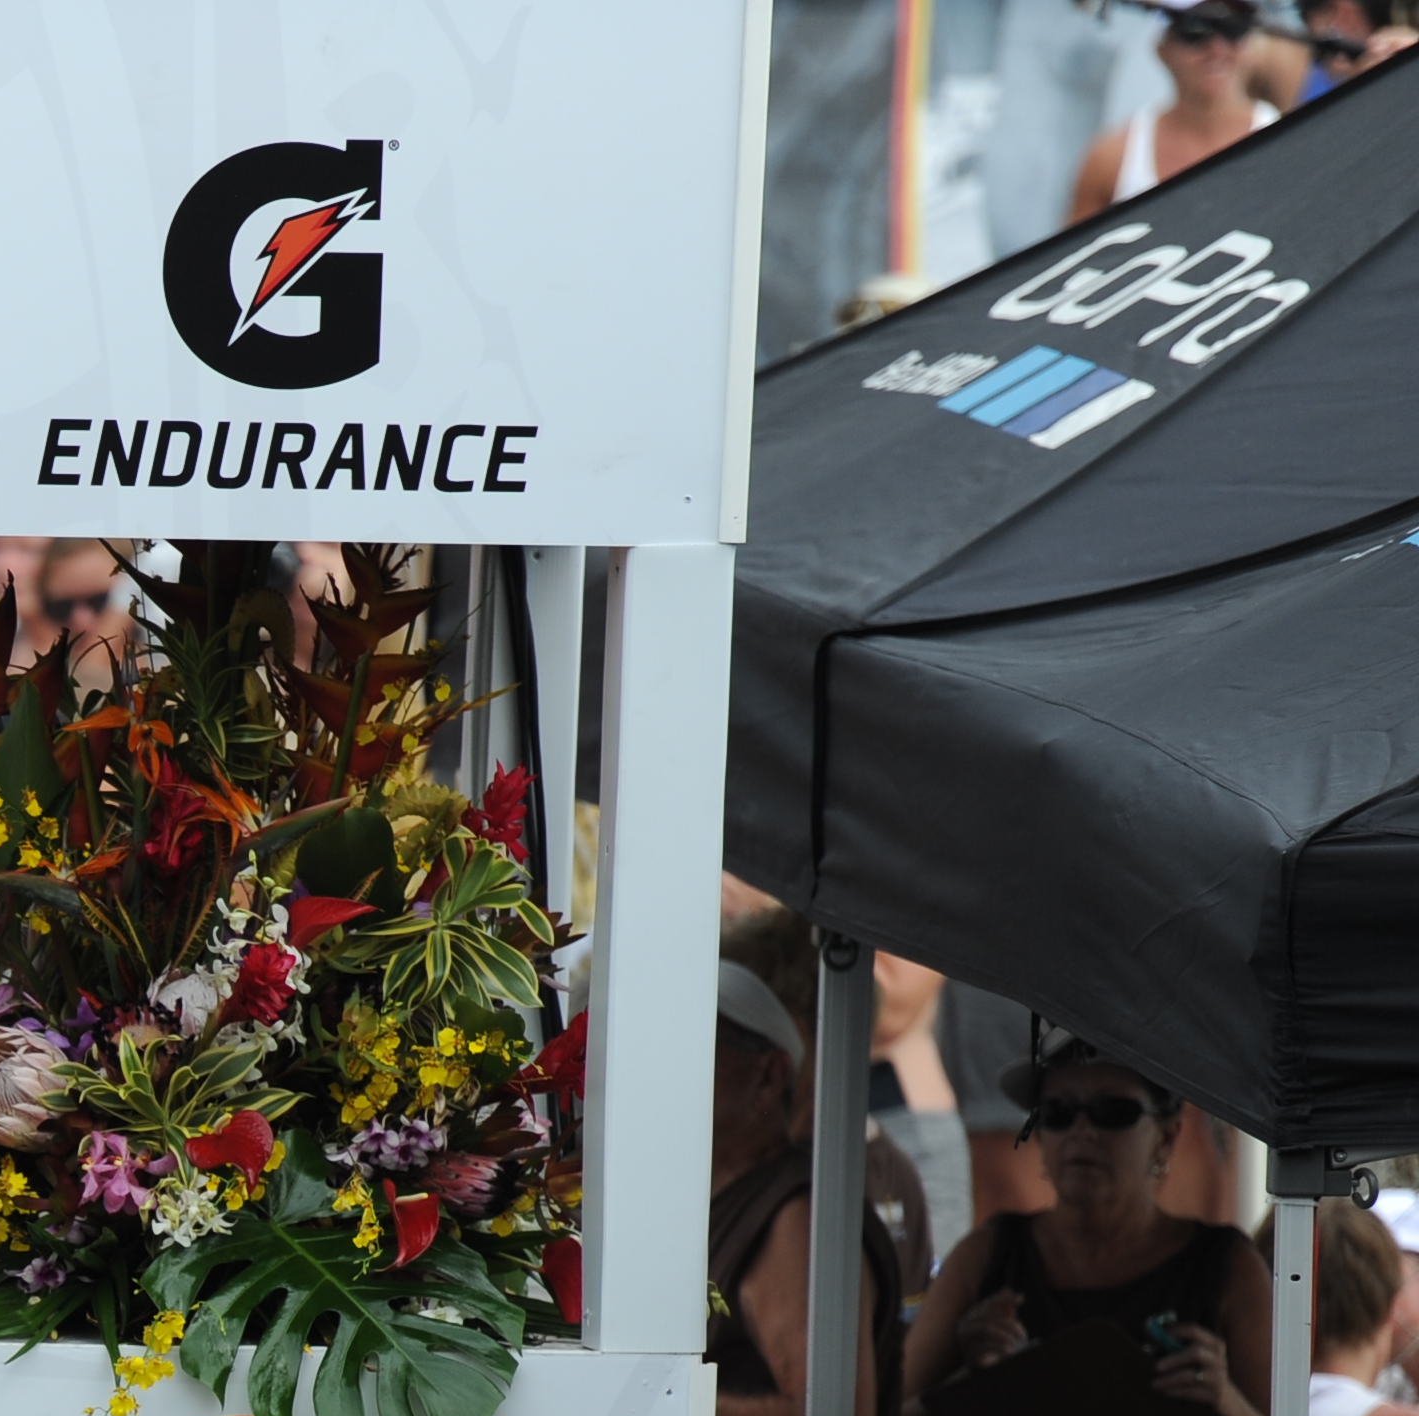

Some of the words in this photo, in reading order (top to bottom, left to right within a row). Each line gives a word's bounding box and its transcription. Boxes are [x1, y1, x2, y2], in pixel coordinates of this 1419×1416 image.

[162, 138, 385, 390] G
[989, 223, 1311, 364] GoPro
[37, 418, 539, 493] ENDURANCE
